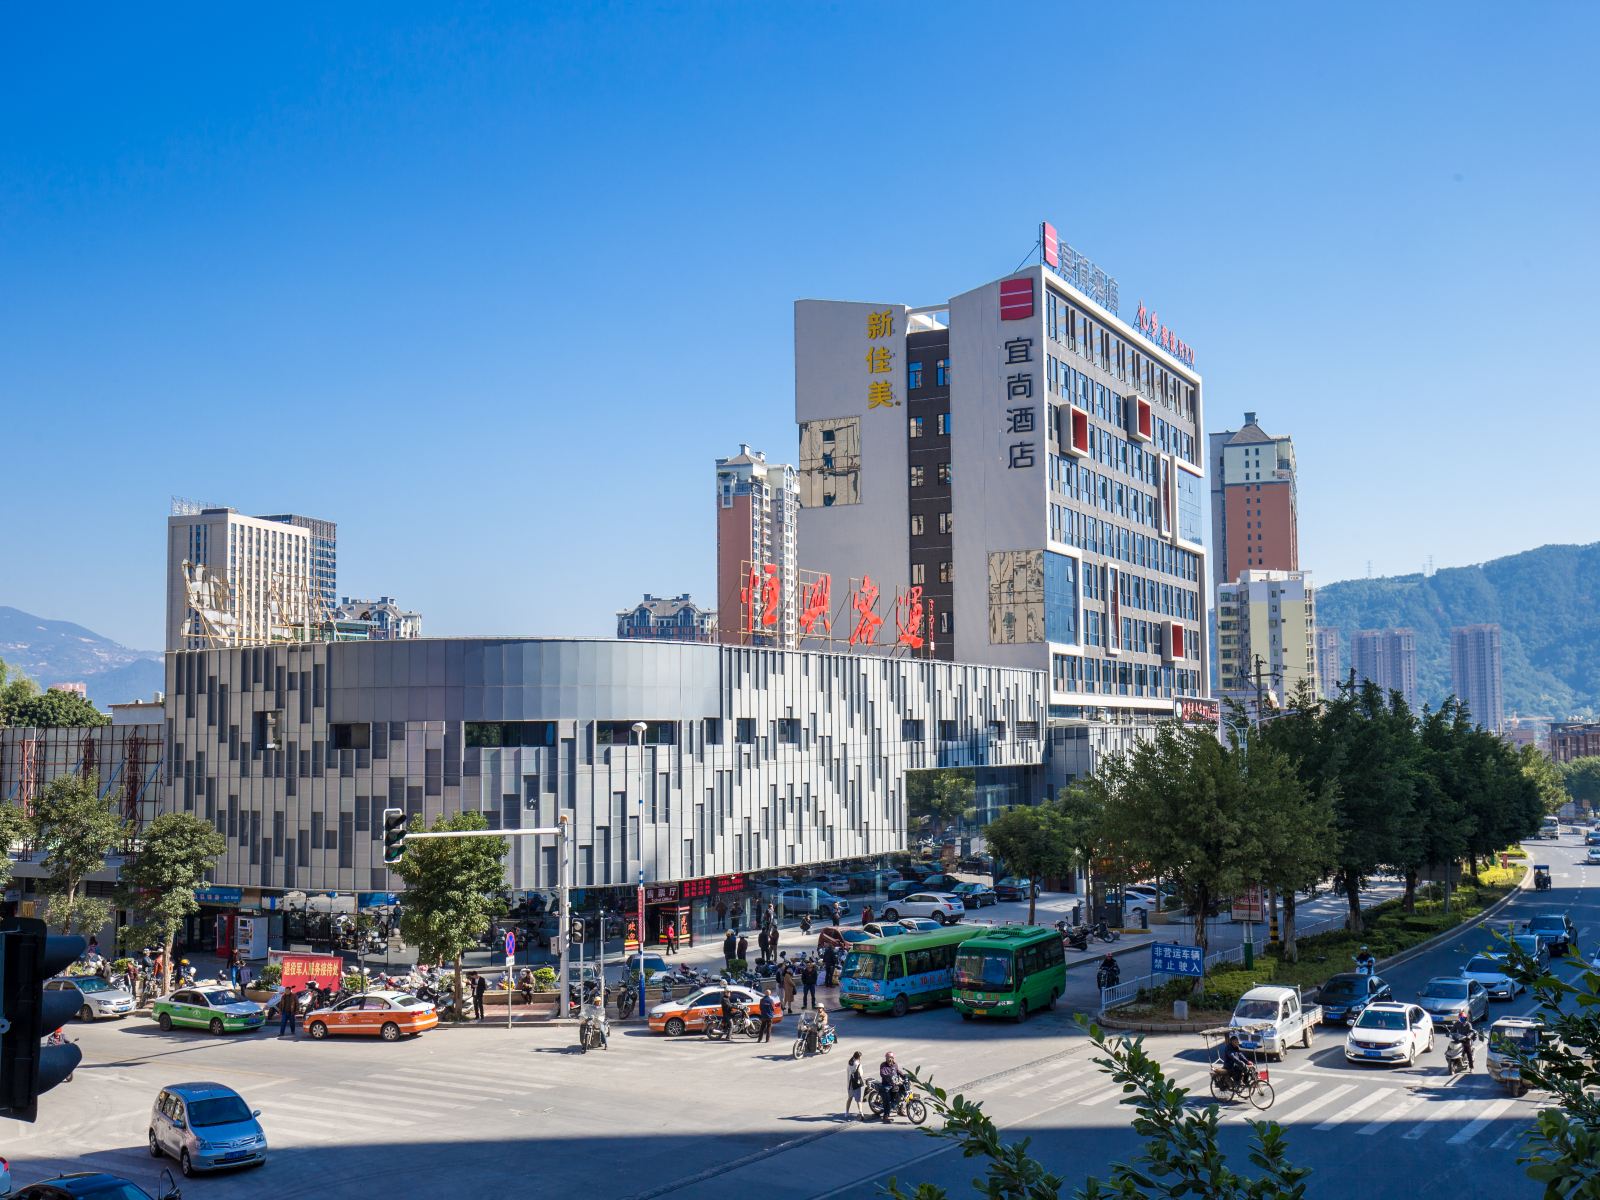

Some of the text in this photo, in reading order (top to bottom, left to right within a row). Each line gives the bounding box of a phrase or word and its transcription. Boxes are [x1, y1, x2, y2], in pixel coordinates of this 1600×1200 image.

[866, 309, 894, 409] 新佳美
[1004, 336, 1035, 470] 宜尚酒店
[647, 887, 677, 898] 售票厅
[1154, 947, 1200, 961] 非营运车辆
[284, 961, 339, 976] 退役军人服务接待处
[1154, 959, 1200, 973] 禁止驶入
